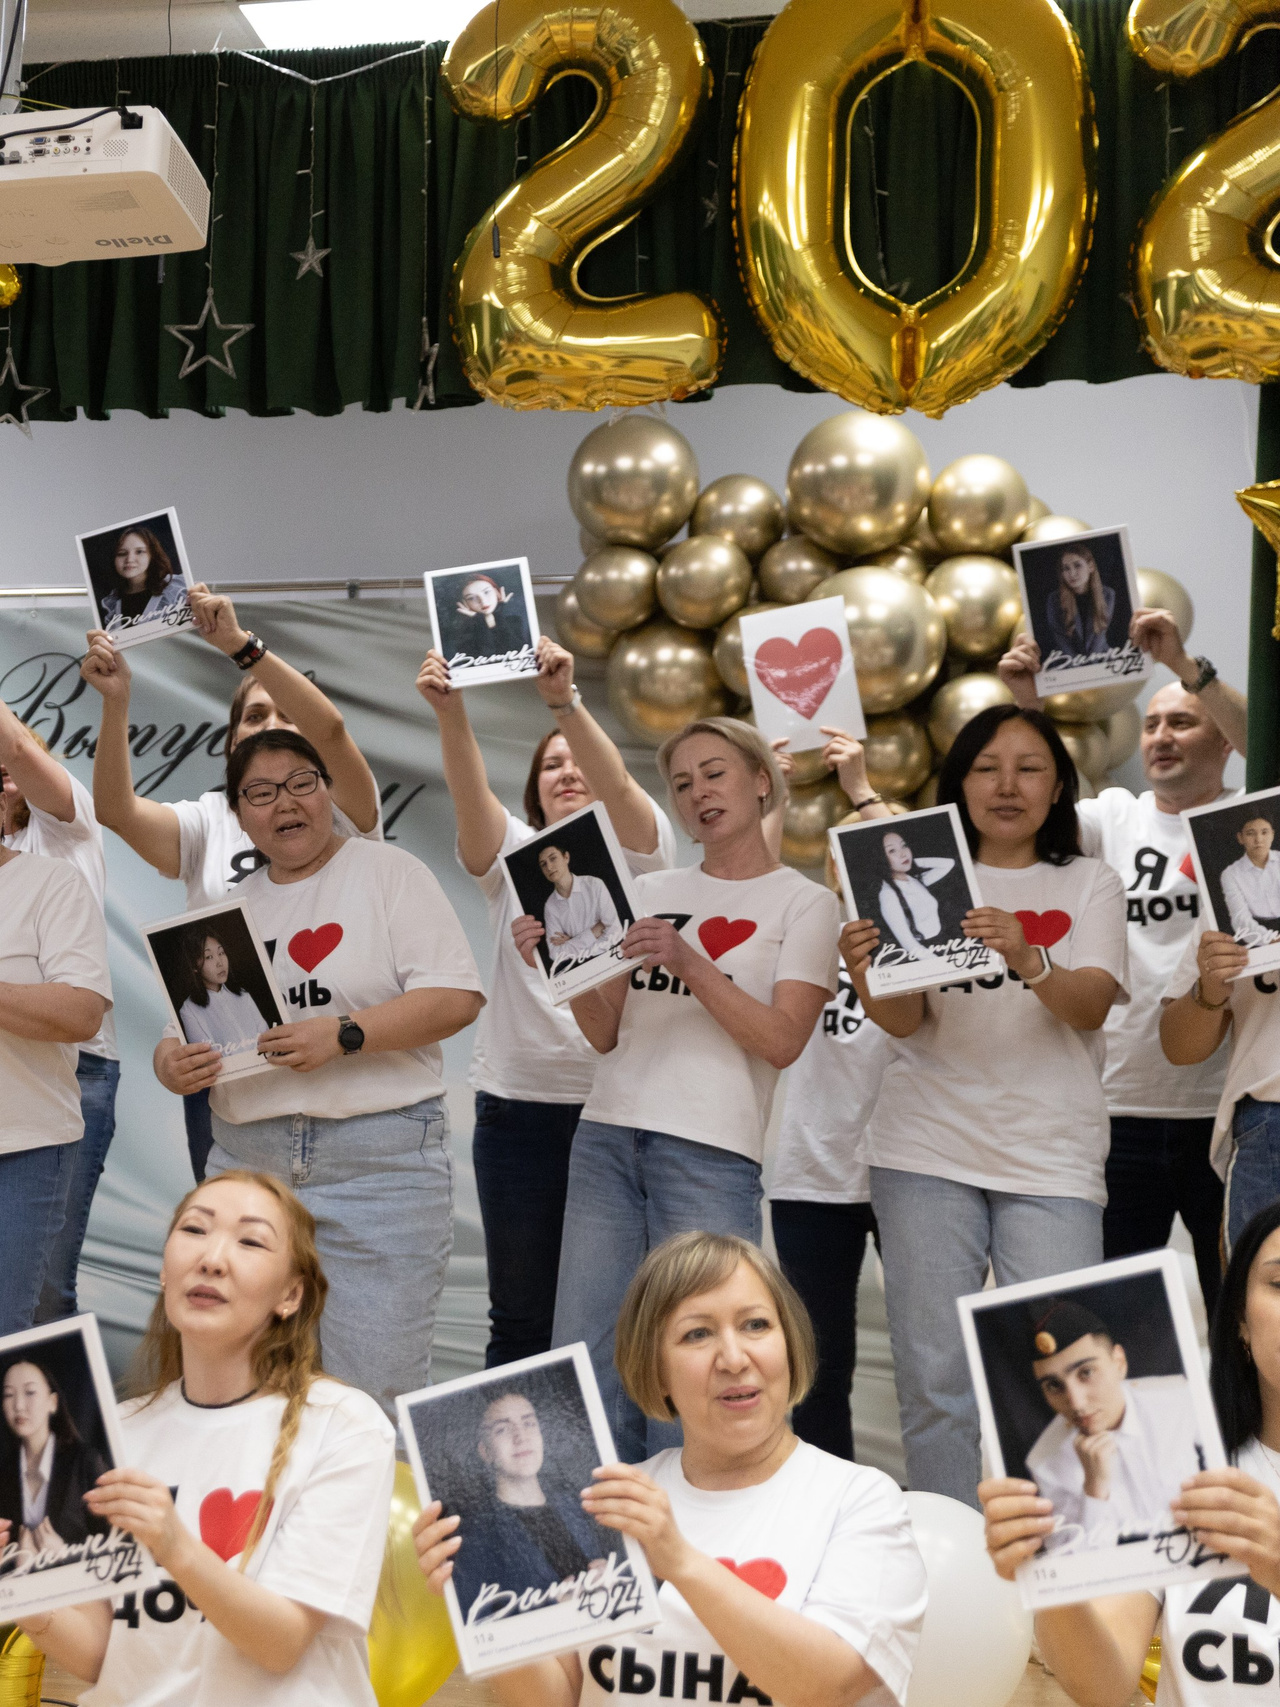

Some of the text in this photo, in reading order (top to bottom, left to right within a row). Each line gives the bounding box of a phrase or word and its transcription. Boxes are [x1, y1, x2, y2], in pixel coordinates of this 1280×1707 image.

[95, 234, 174, 248] Diello
[1127, 847, 1169, 891] Я
[1127, 894, 1199, 926] ДОЧ
[85, 1541, 143, 1584] 2024
[464, 1551, 636, 1627] Выпуск
[577, 1575, 643, 1622] 2024
